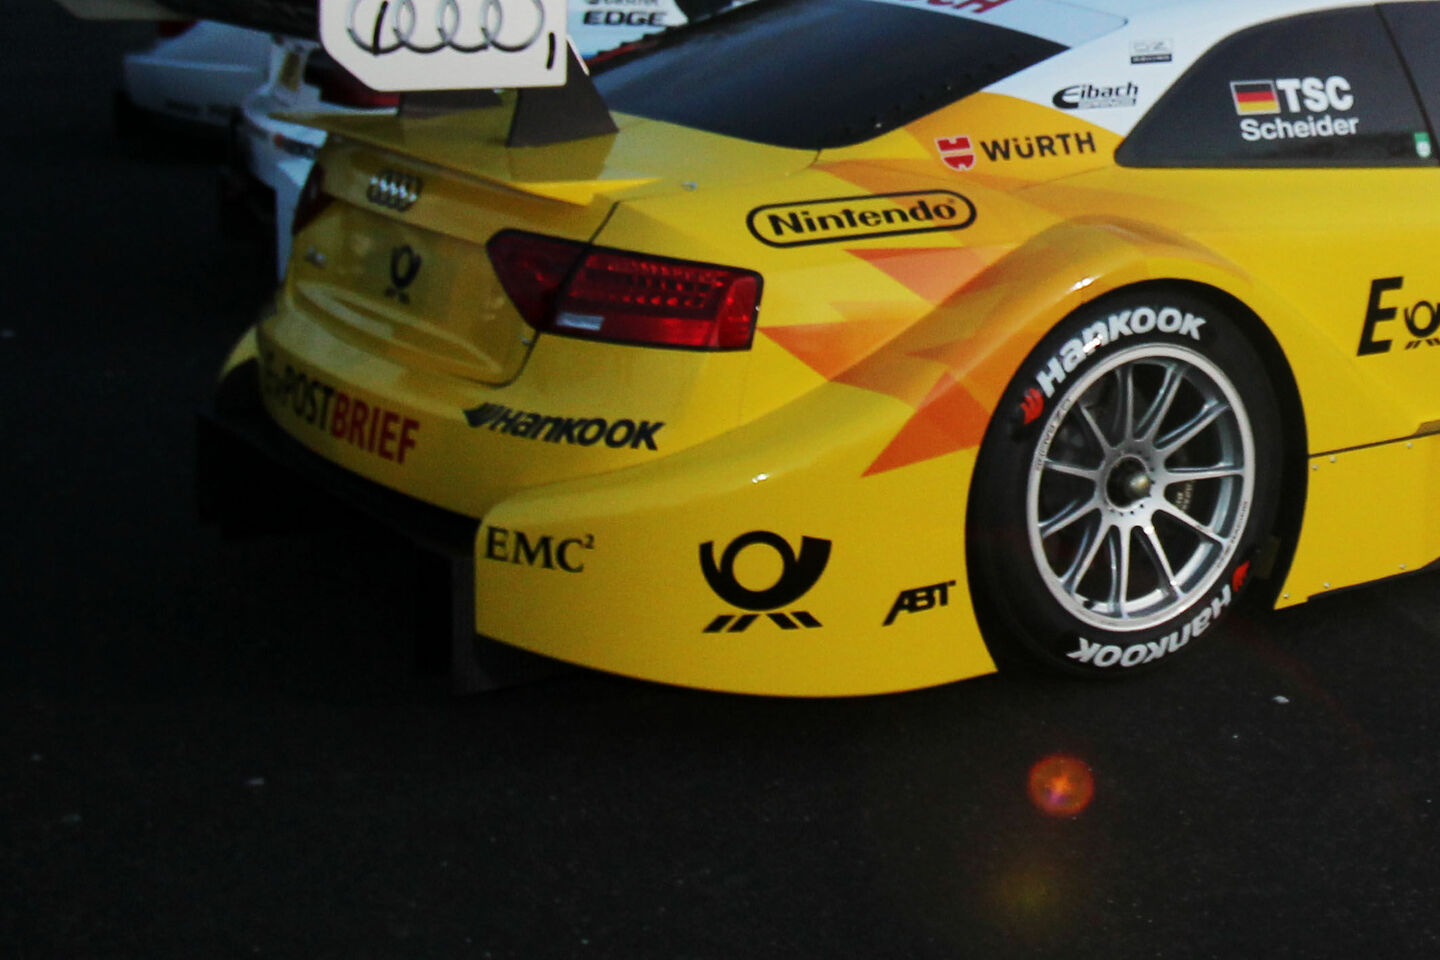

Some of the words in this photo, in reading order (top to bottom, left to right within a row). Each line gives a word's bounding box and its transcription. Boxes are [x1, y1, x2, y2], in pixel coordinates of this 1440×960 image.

[583, 11, 668, 27] EDGE
[1052, 81, 1138, 109] Eibach
[1276, 75, 1354, 113] TSC
[1239, 115, 1360, 141] Scheider
[767, 198, 956, 236] Nintendo
[882, 580, 957, 627] ABT
